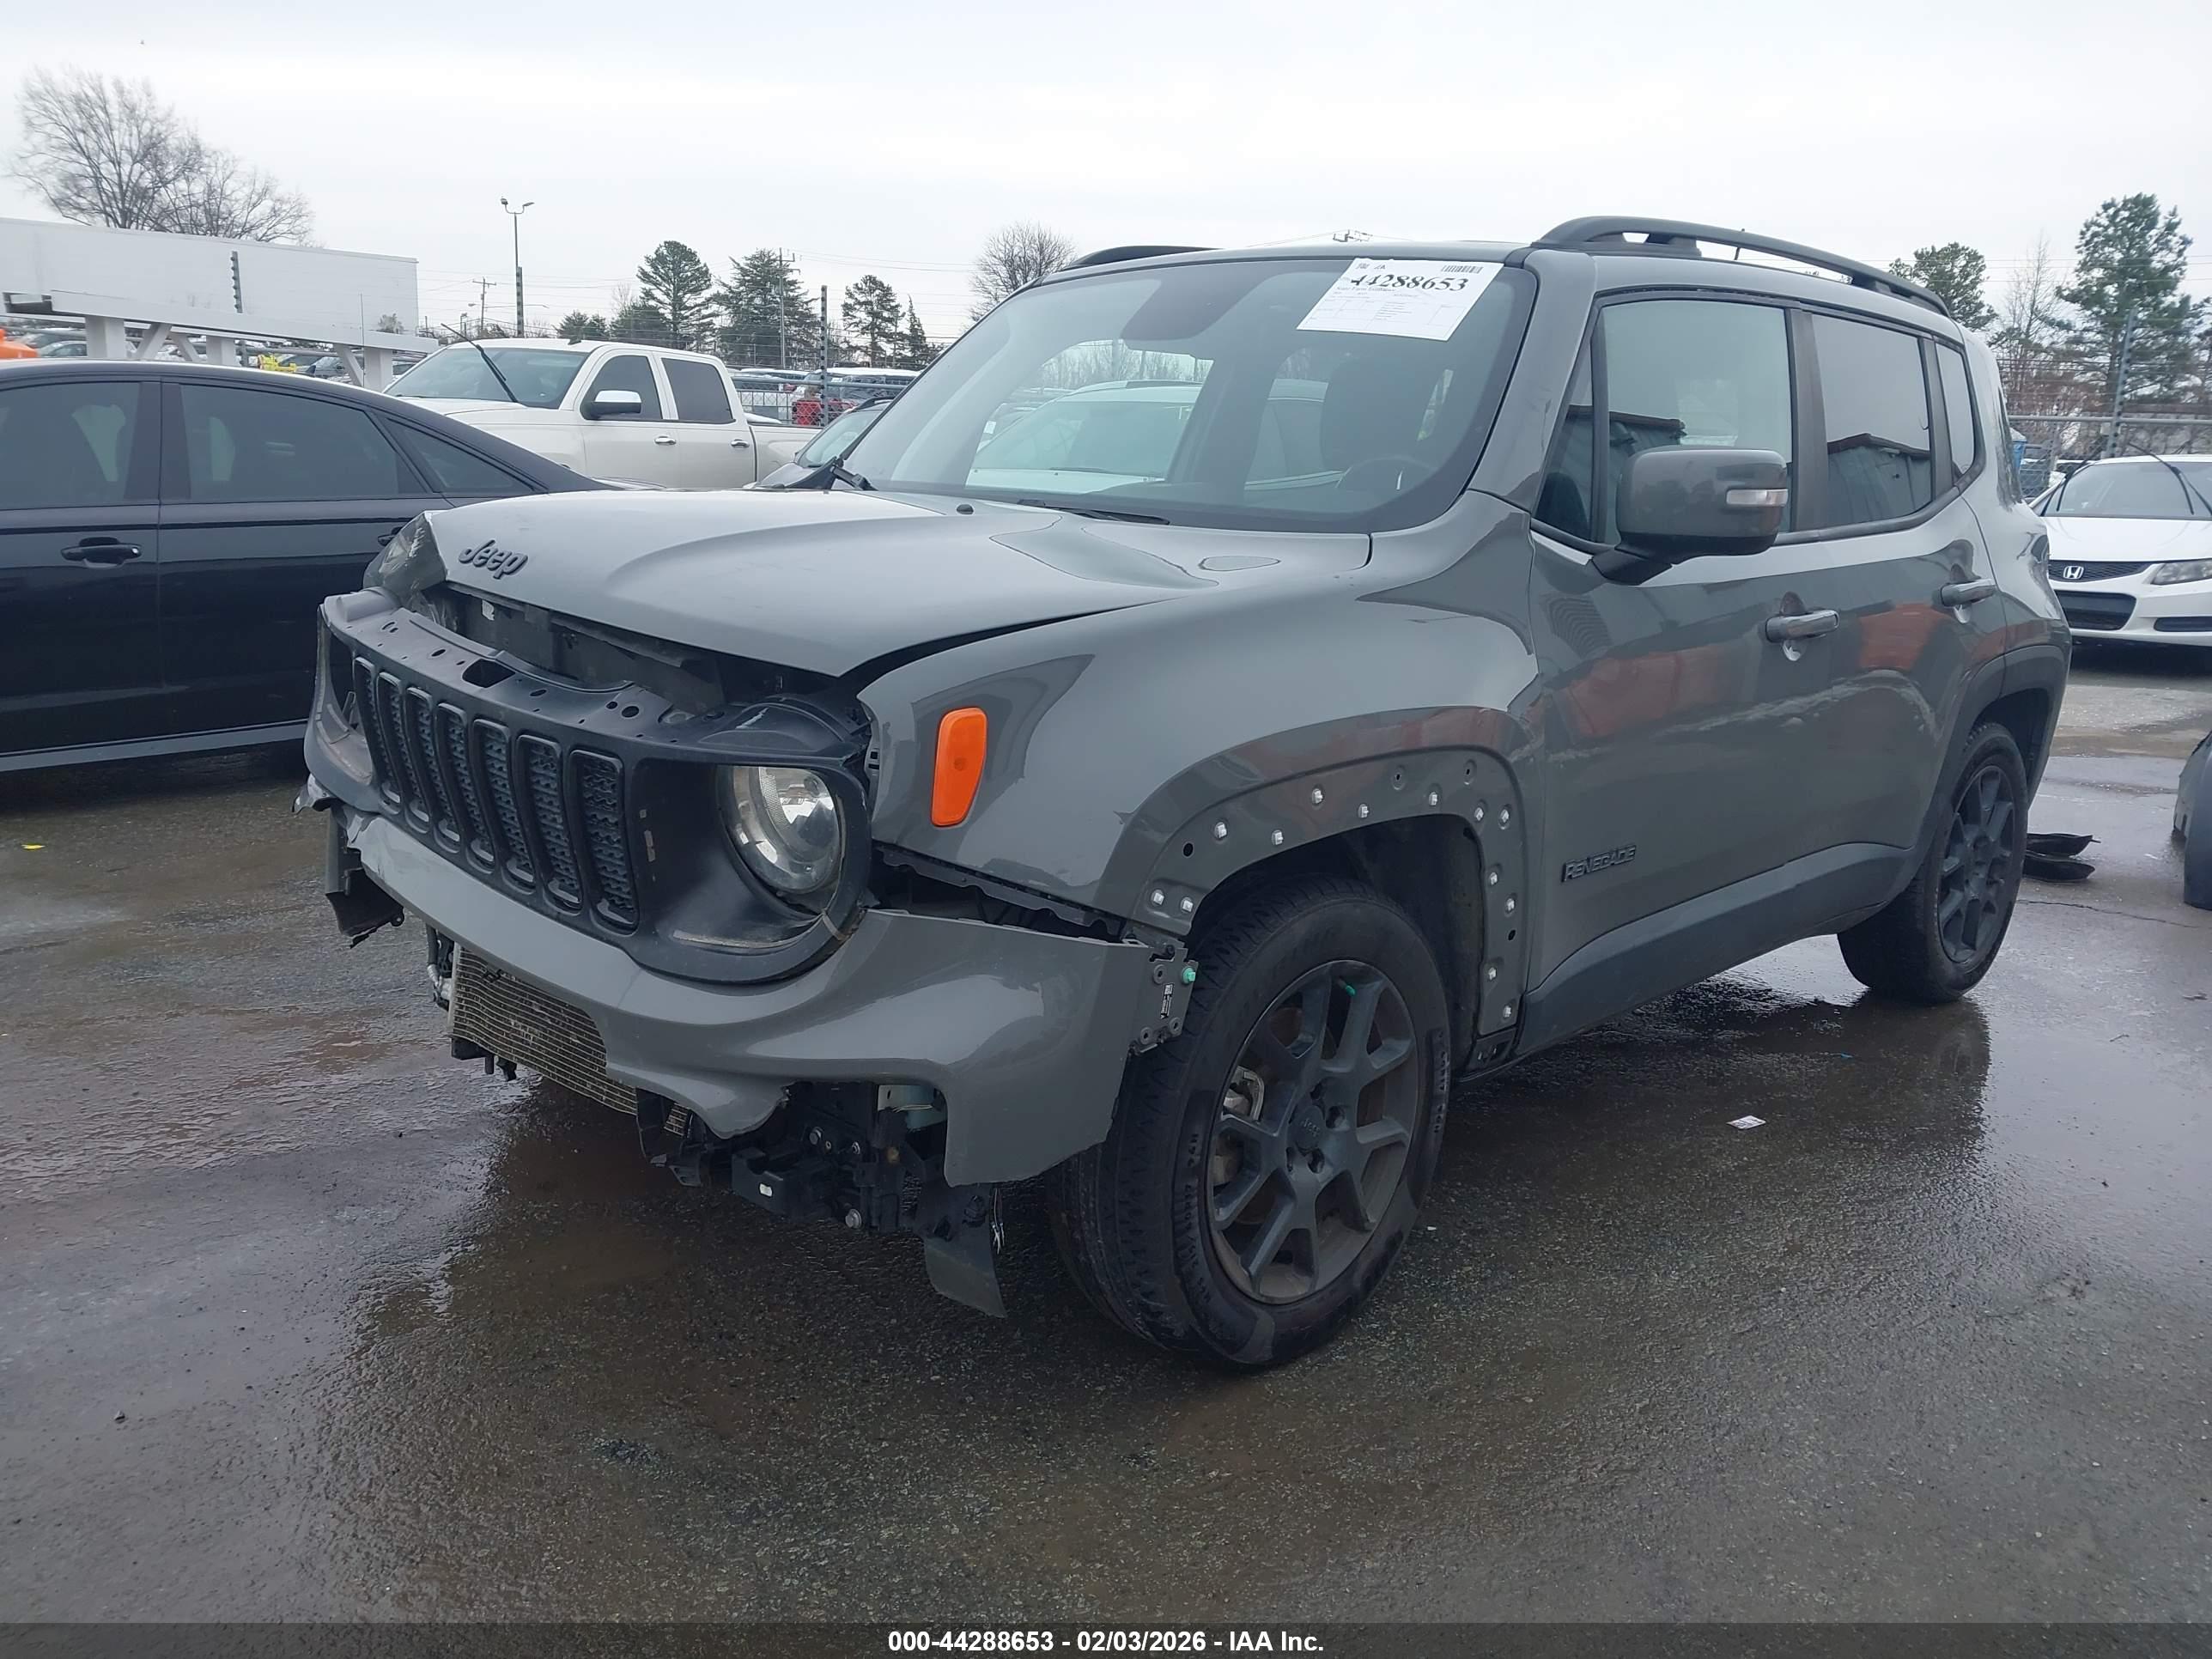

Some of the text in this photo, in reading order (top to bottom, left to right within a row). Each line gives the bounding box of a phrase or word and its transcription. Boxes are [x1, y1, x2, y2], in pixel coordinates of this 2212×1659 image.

[1351, 274, 1468, 291] 44288653
[459, 538, 529, 580] Jeep
[1561, 844, 1637, 882] RENEGADE
